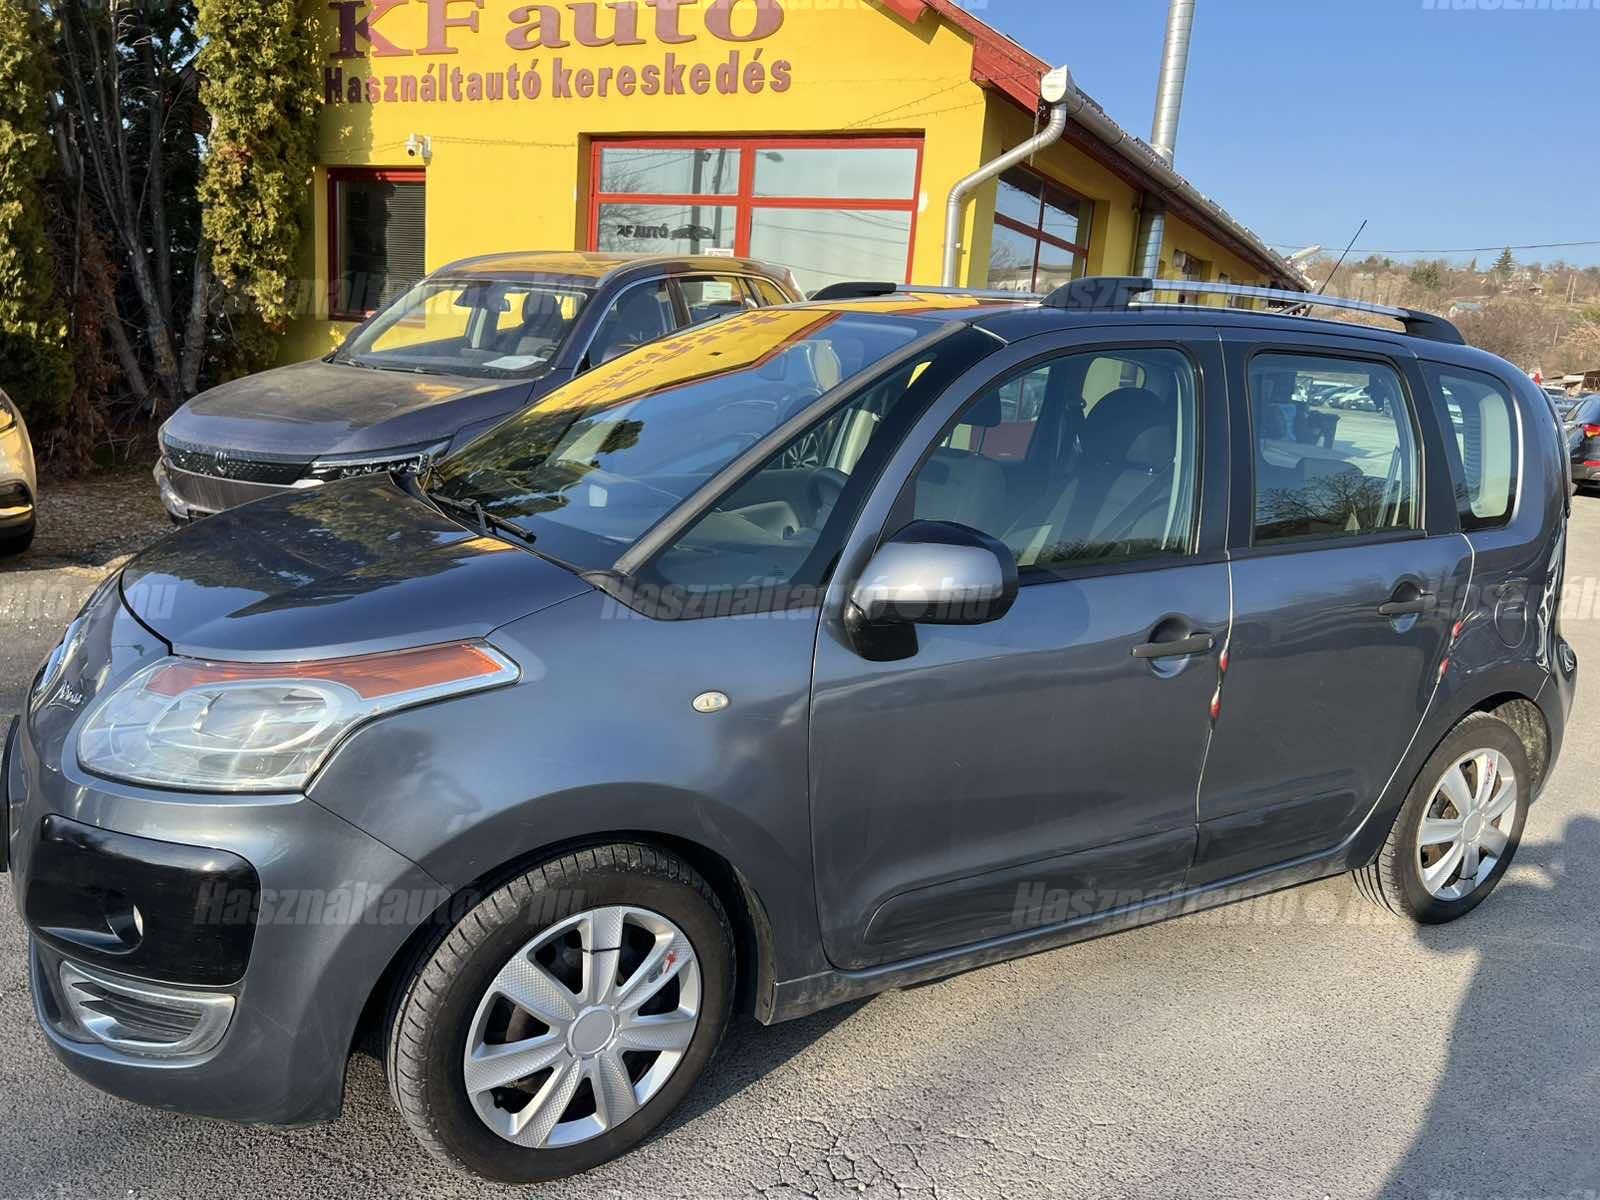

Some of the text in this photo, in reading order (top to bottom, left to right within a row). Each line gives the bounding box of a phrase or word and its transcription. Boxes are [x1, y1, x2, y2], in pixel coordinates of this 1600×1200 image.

[328, 0, 486, 59] KF
[323, 47, 792, 104] Használtautó kereskedés
